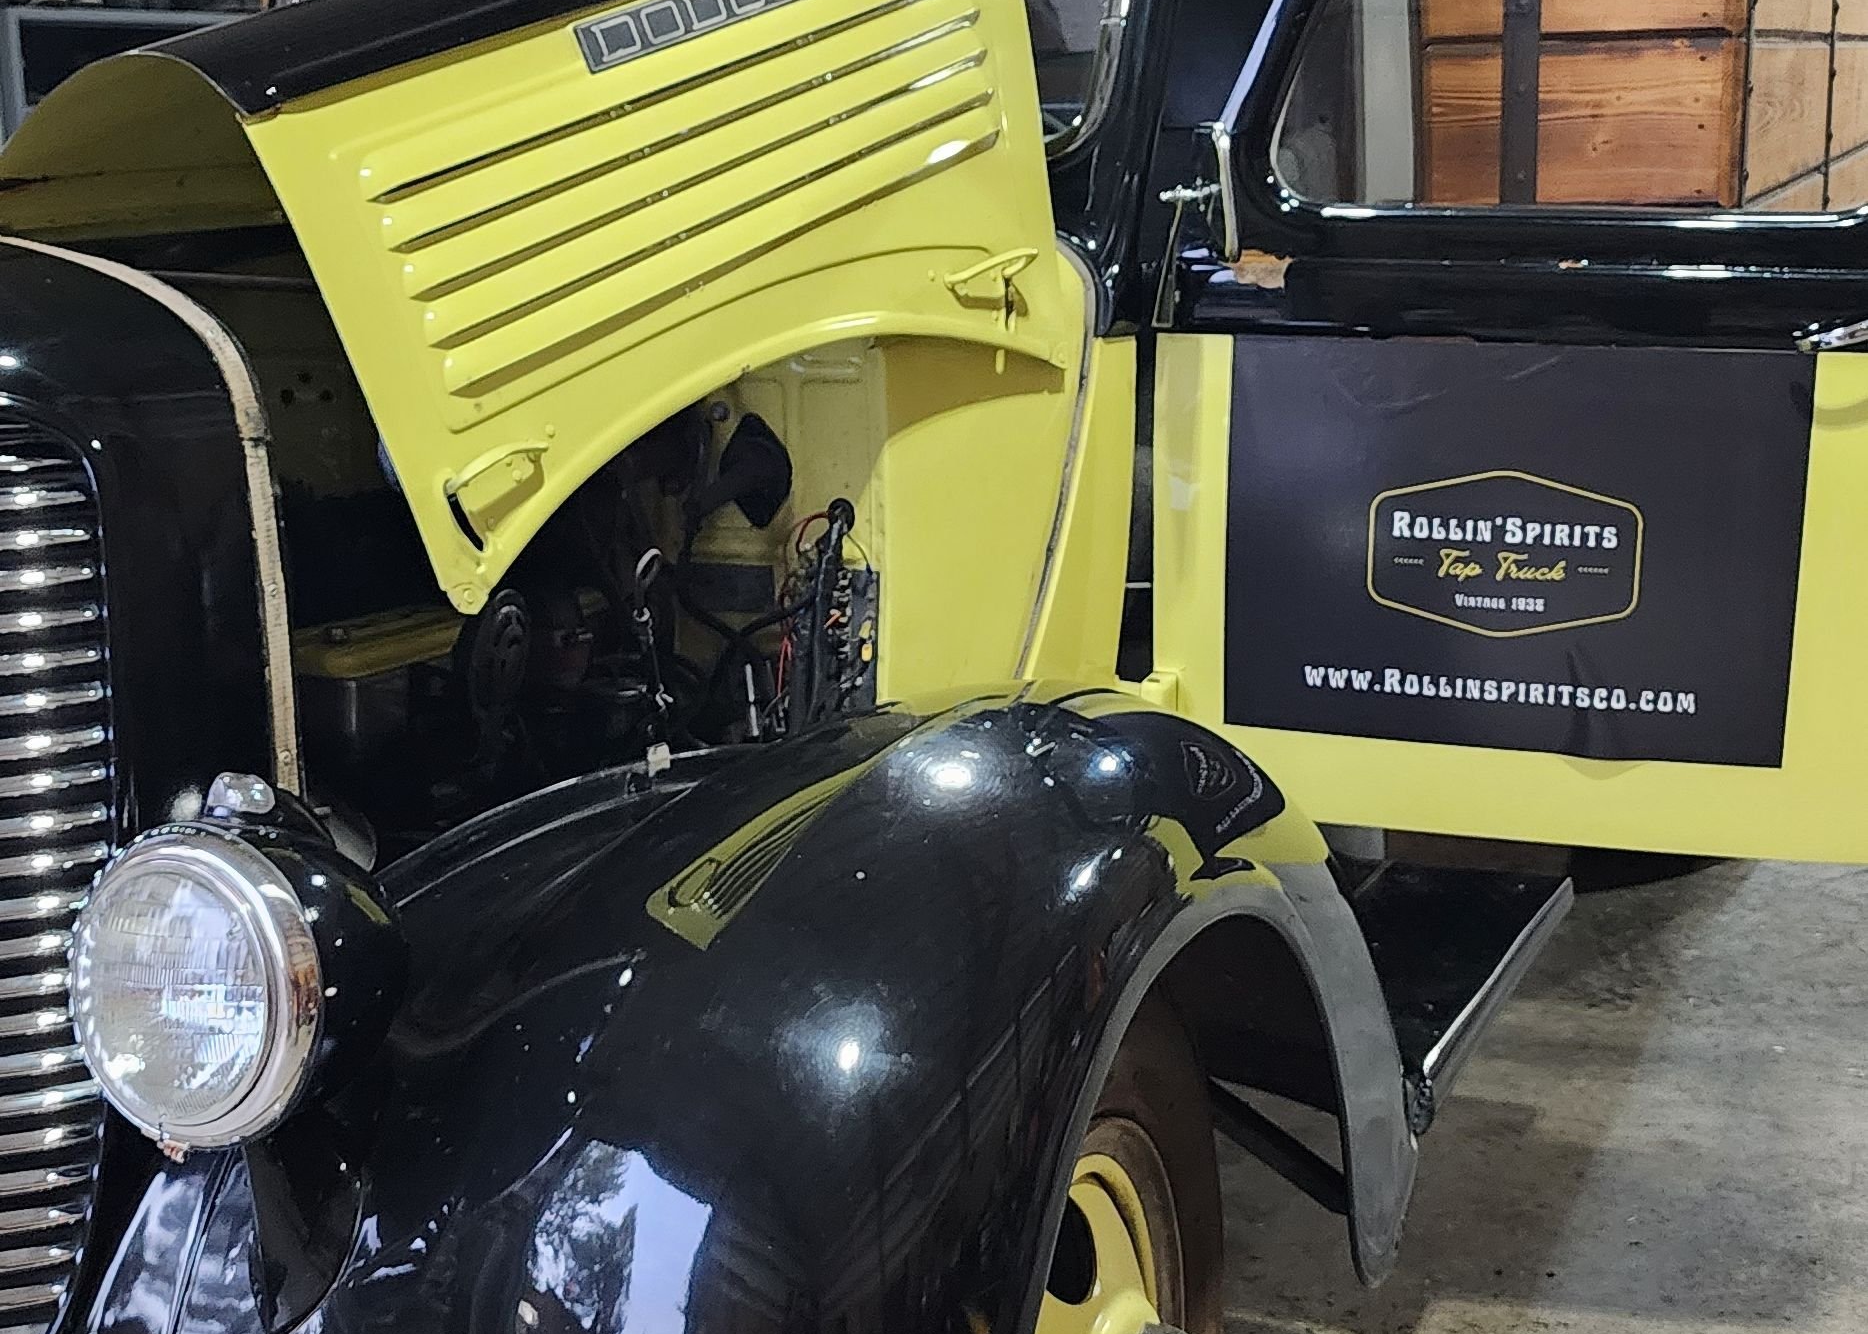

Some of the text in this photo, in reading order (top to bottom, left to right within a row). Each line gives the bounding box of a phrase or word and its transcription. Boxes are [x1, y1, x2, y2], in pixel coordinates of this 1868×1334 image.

[1437, 547, 1568, 583] Tap Truck
[1454, 593, 1546, 612] VINTAGE 1938
